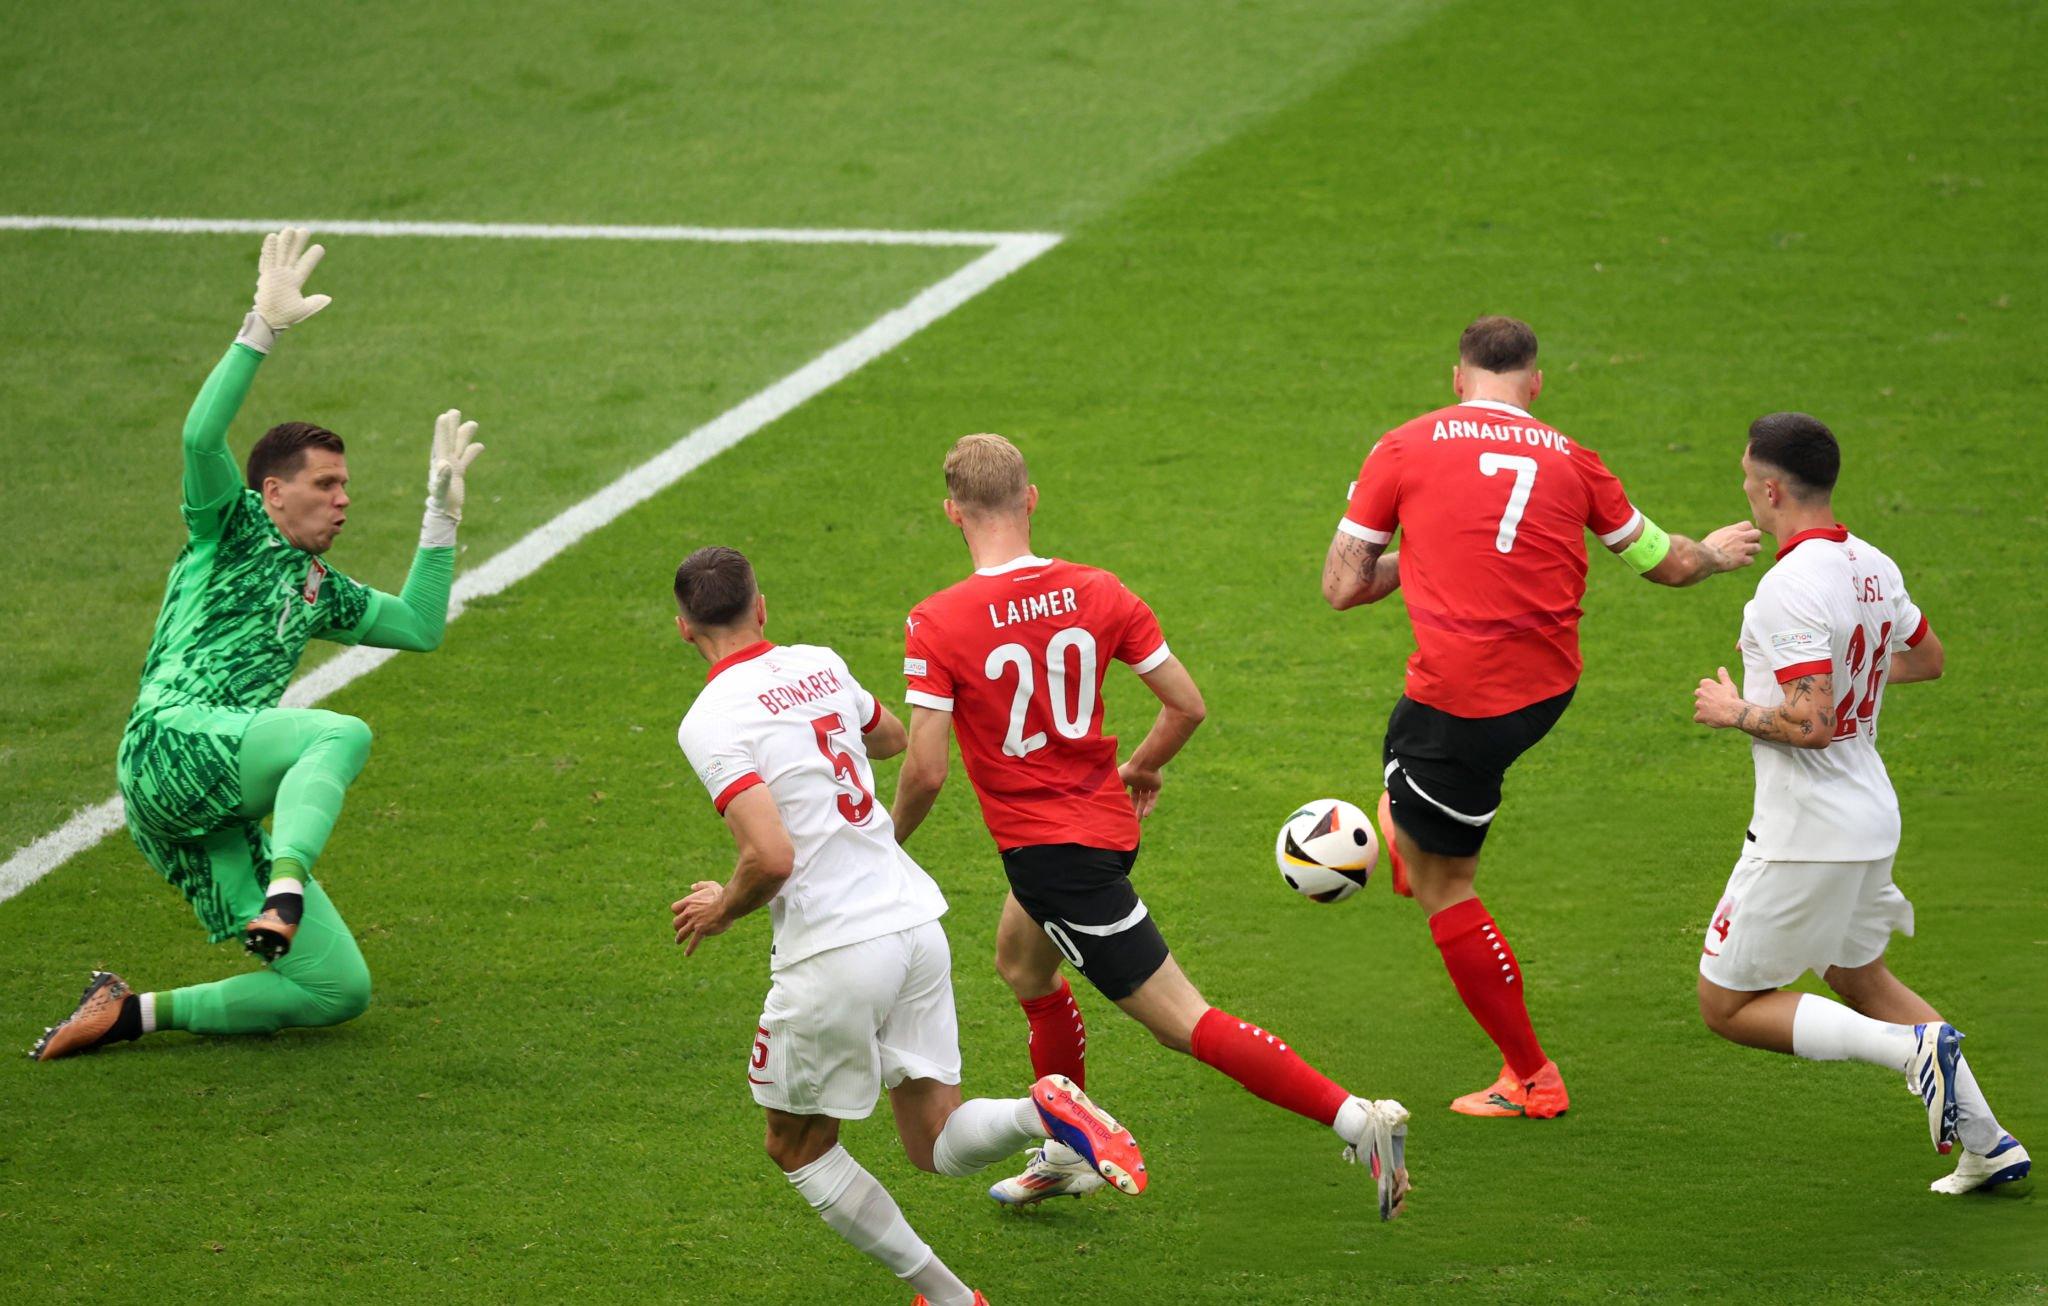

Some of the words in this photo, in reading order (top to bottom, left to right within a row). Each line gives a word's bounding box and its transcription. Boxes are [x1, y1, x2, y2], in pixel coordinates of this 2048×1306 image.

[1432, 420, 1571, 456] ARNAUTOVIC
[1479, 452, 1538, 553] 7
[989, 587, 1078, 628] LAIMER
[757, 667, 843, 715] BEDNAREK
[984, 627, 1097, 758] 20
[810, 712, 875, 827] 5
[751, 1026, 772, 1072] 5
[1058, 1091, 1113, 1142] PREDATOR
